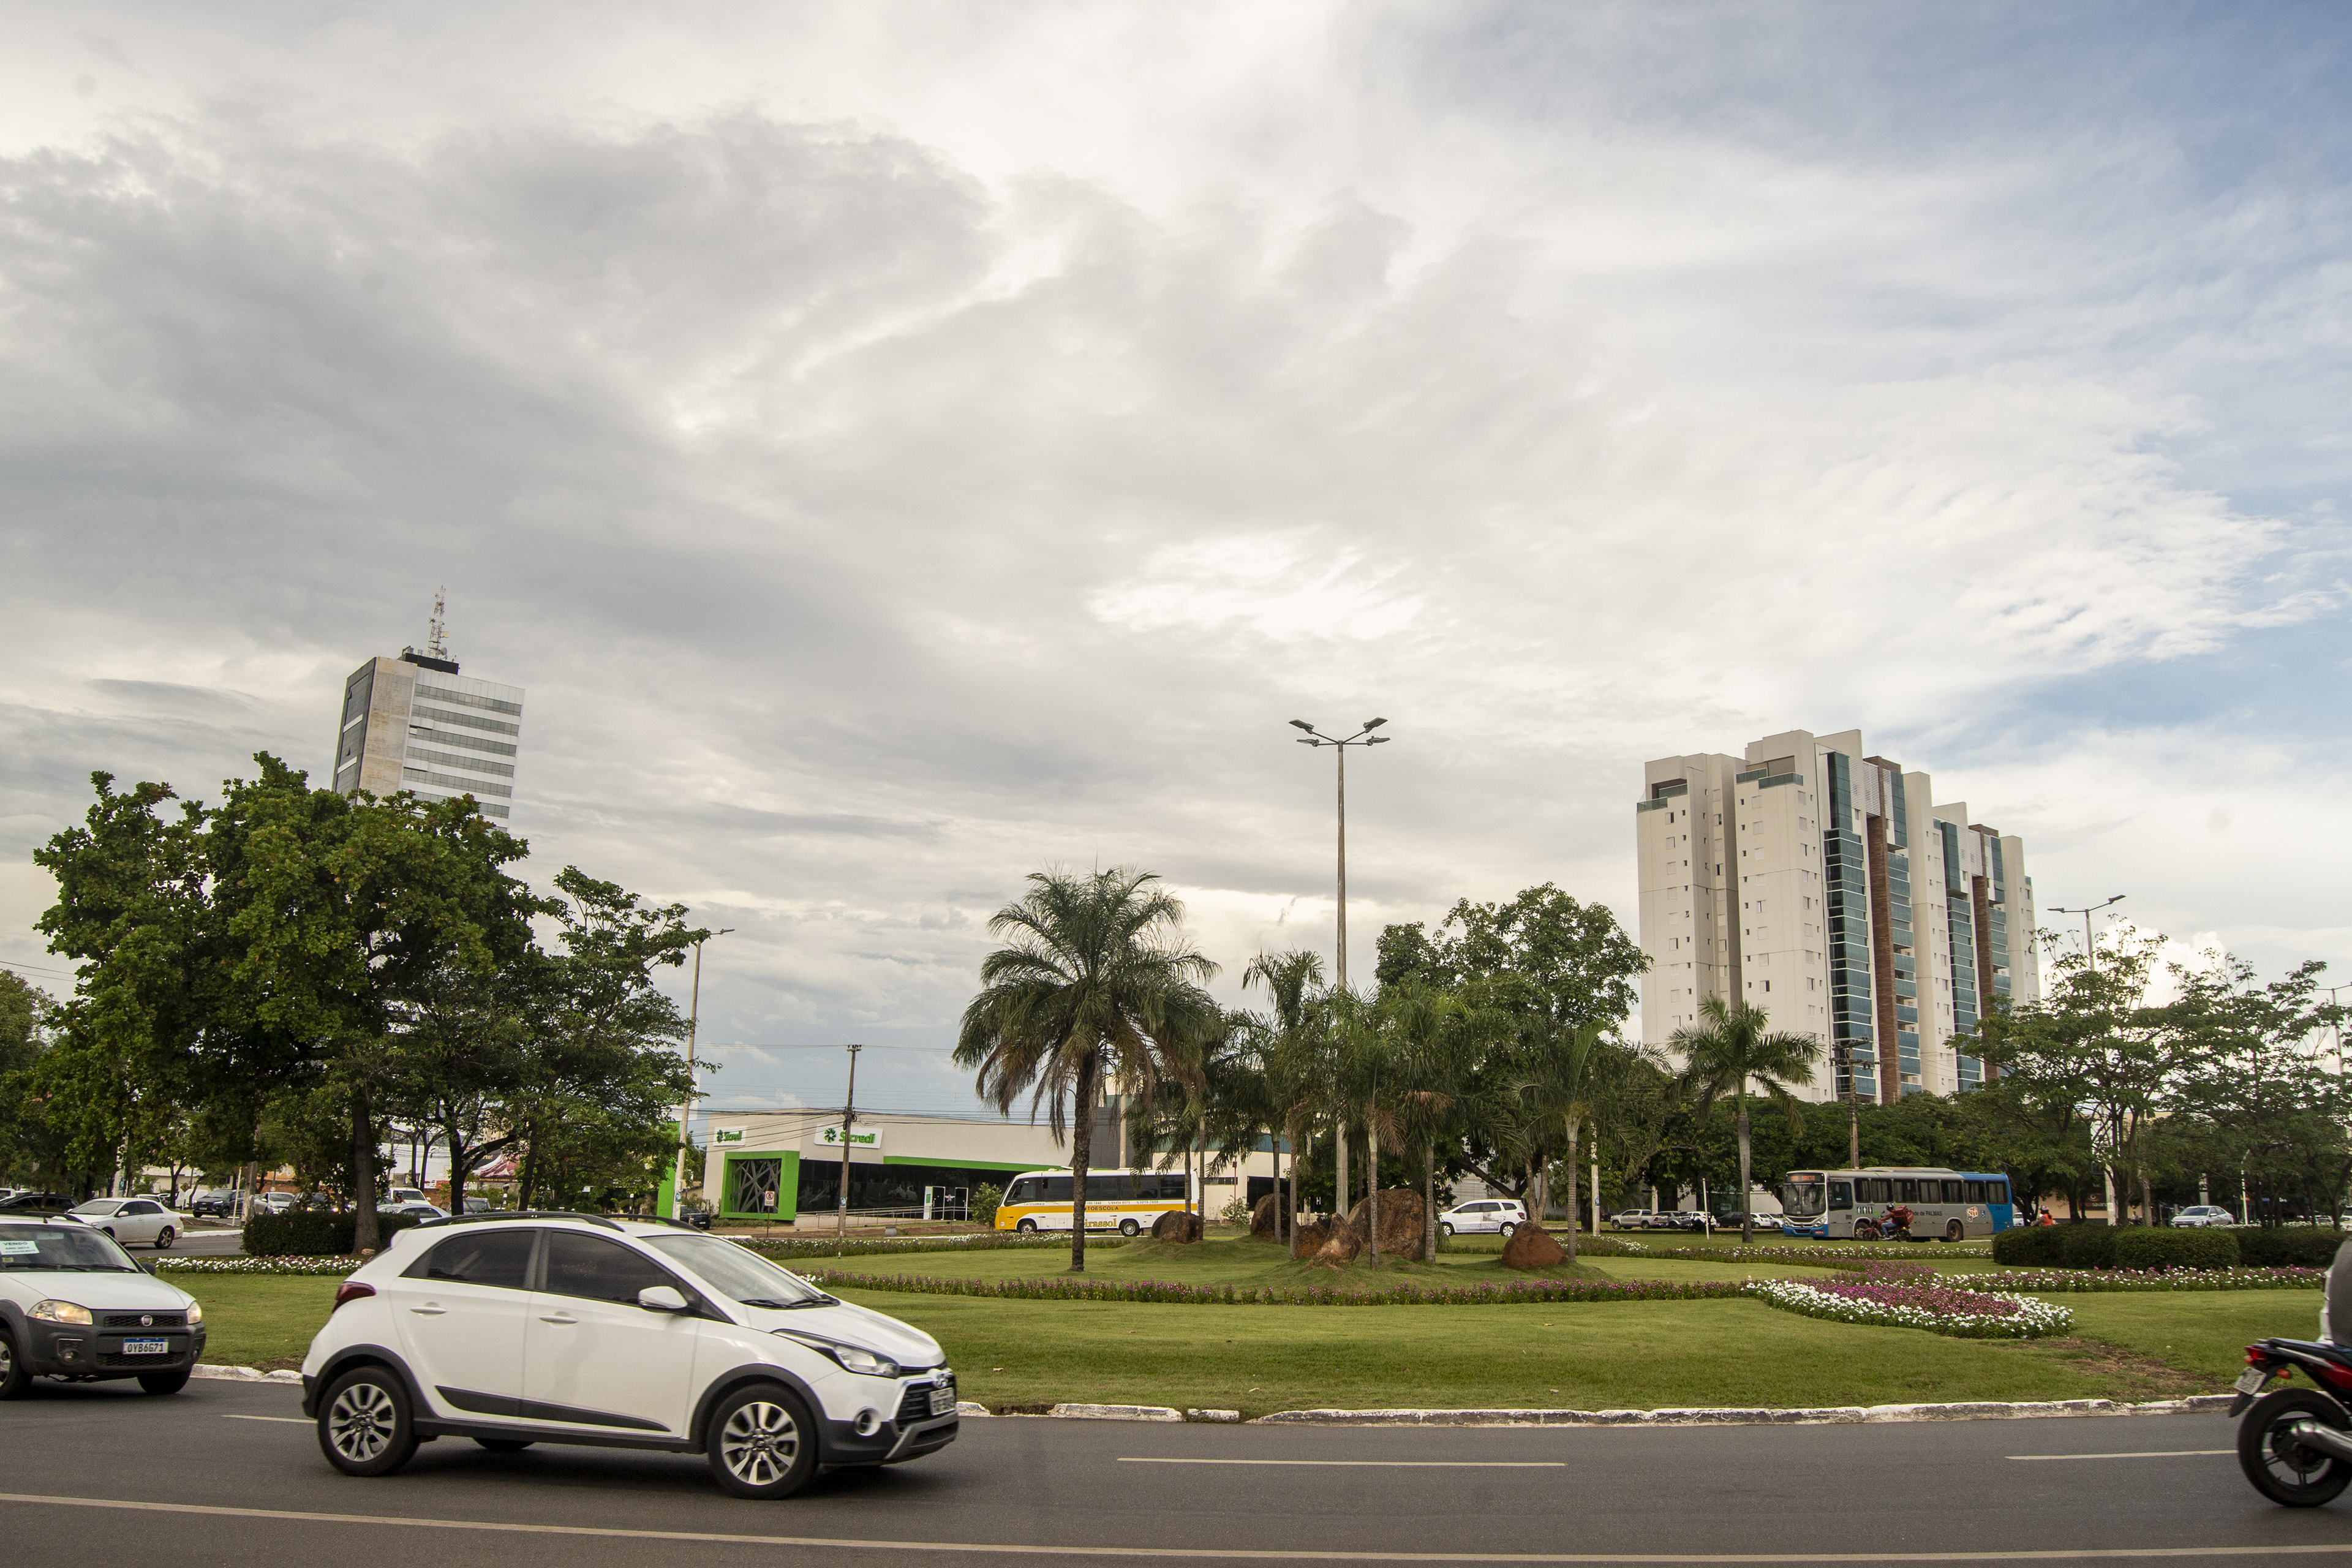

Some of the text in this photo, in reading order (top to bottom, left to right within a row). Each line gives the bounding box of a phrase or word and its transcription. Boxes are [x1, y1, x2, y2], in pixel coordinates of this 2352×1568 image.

[723, 1130, 742, 1141] Sicredi
[839, 1131, 876, 1144] Scredi
[1085, 1218, 1117, 1227] irassol
[127, 1343, 164, 1352] OYB6G71
